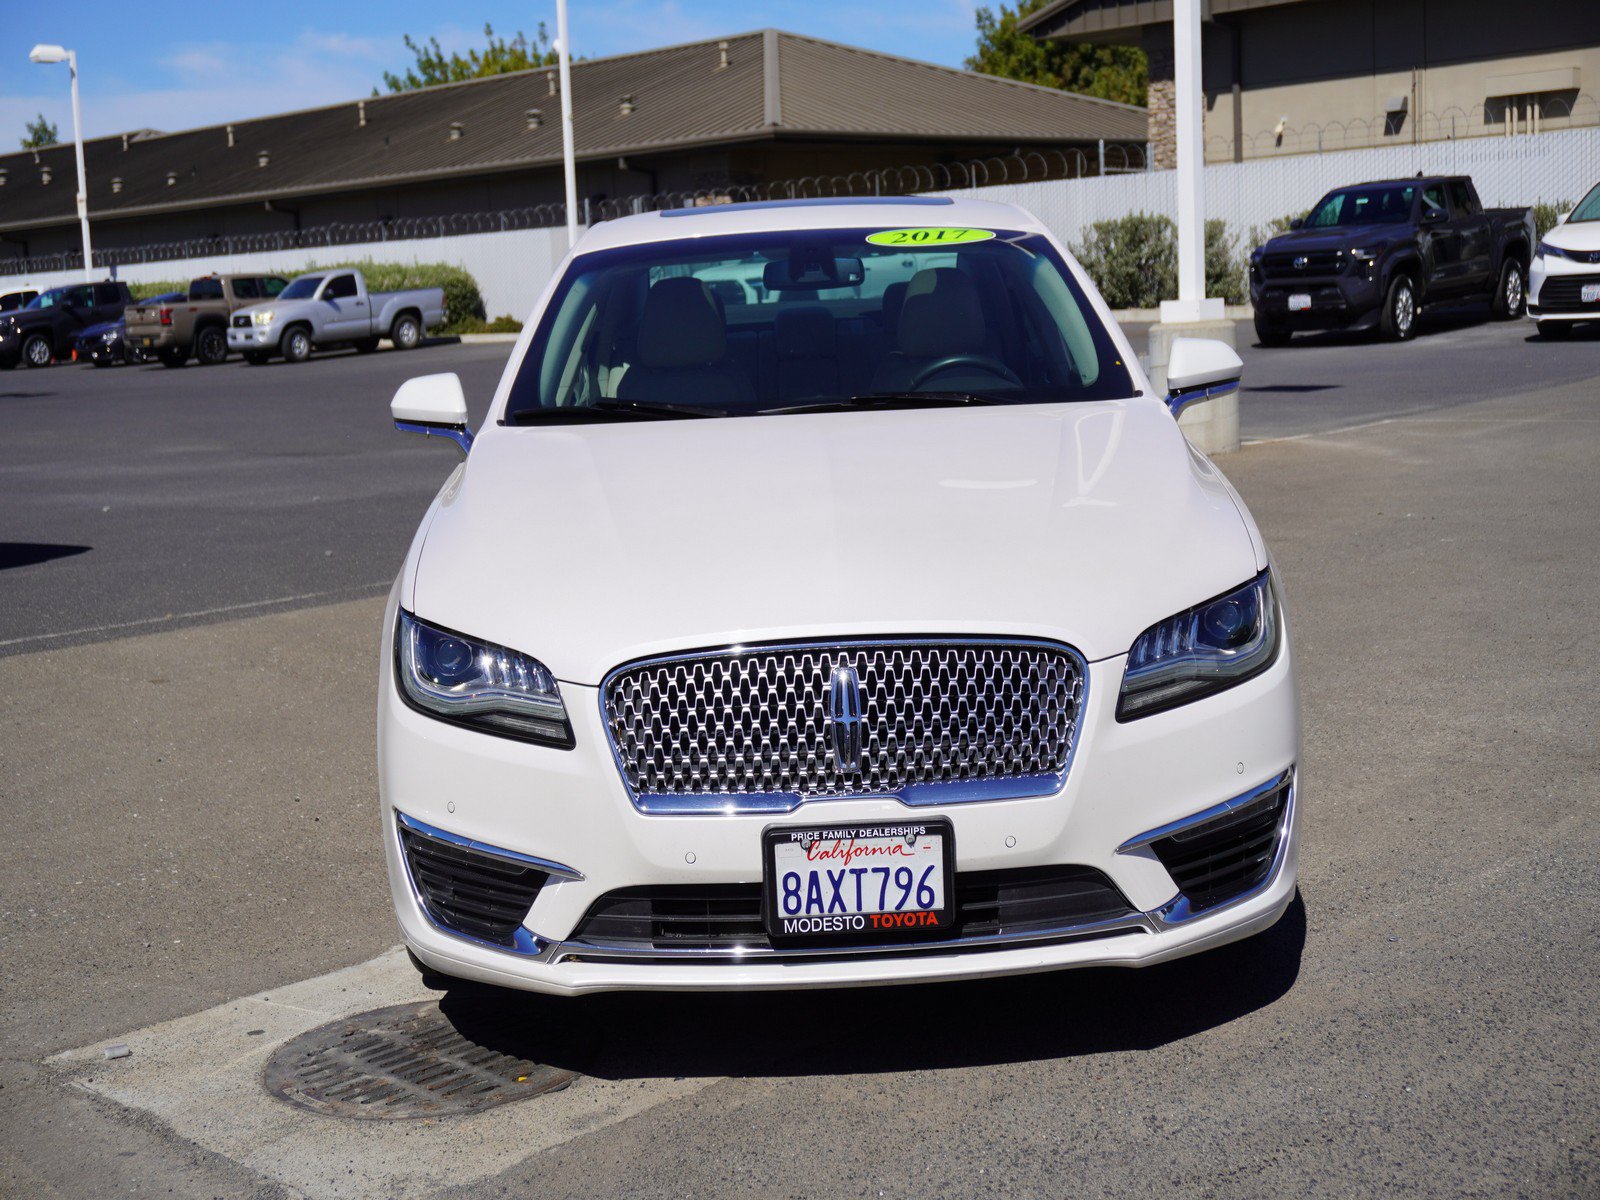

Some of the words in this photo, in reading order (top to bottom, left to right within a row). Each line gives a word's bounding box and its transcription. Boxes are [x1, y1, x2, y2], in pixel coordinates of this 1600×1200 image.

[890, 230, 969, 244] 2017
[791, 832, 820, 842] PRICE
[822, 829, 857, 840] FAMILY
[859, 826, 926, 838] DEALERSHIPS
[806, 838, 915, 866] California
[782, 864, 936, 916] 8AXT796
[784, 915, 865, 934] MODESTO
[869, 911, 938, 929] TOYOTA
